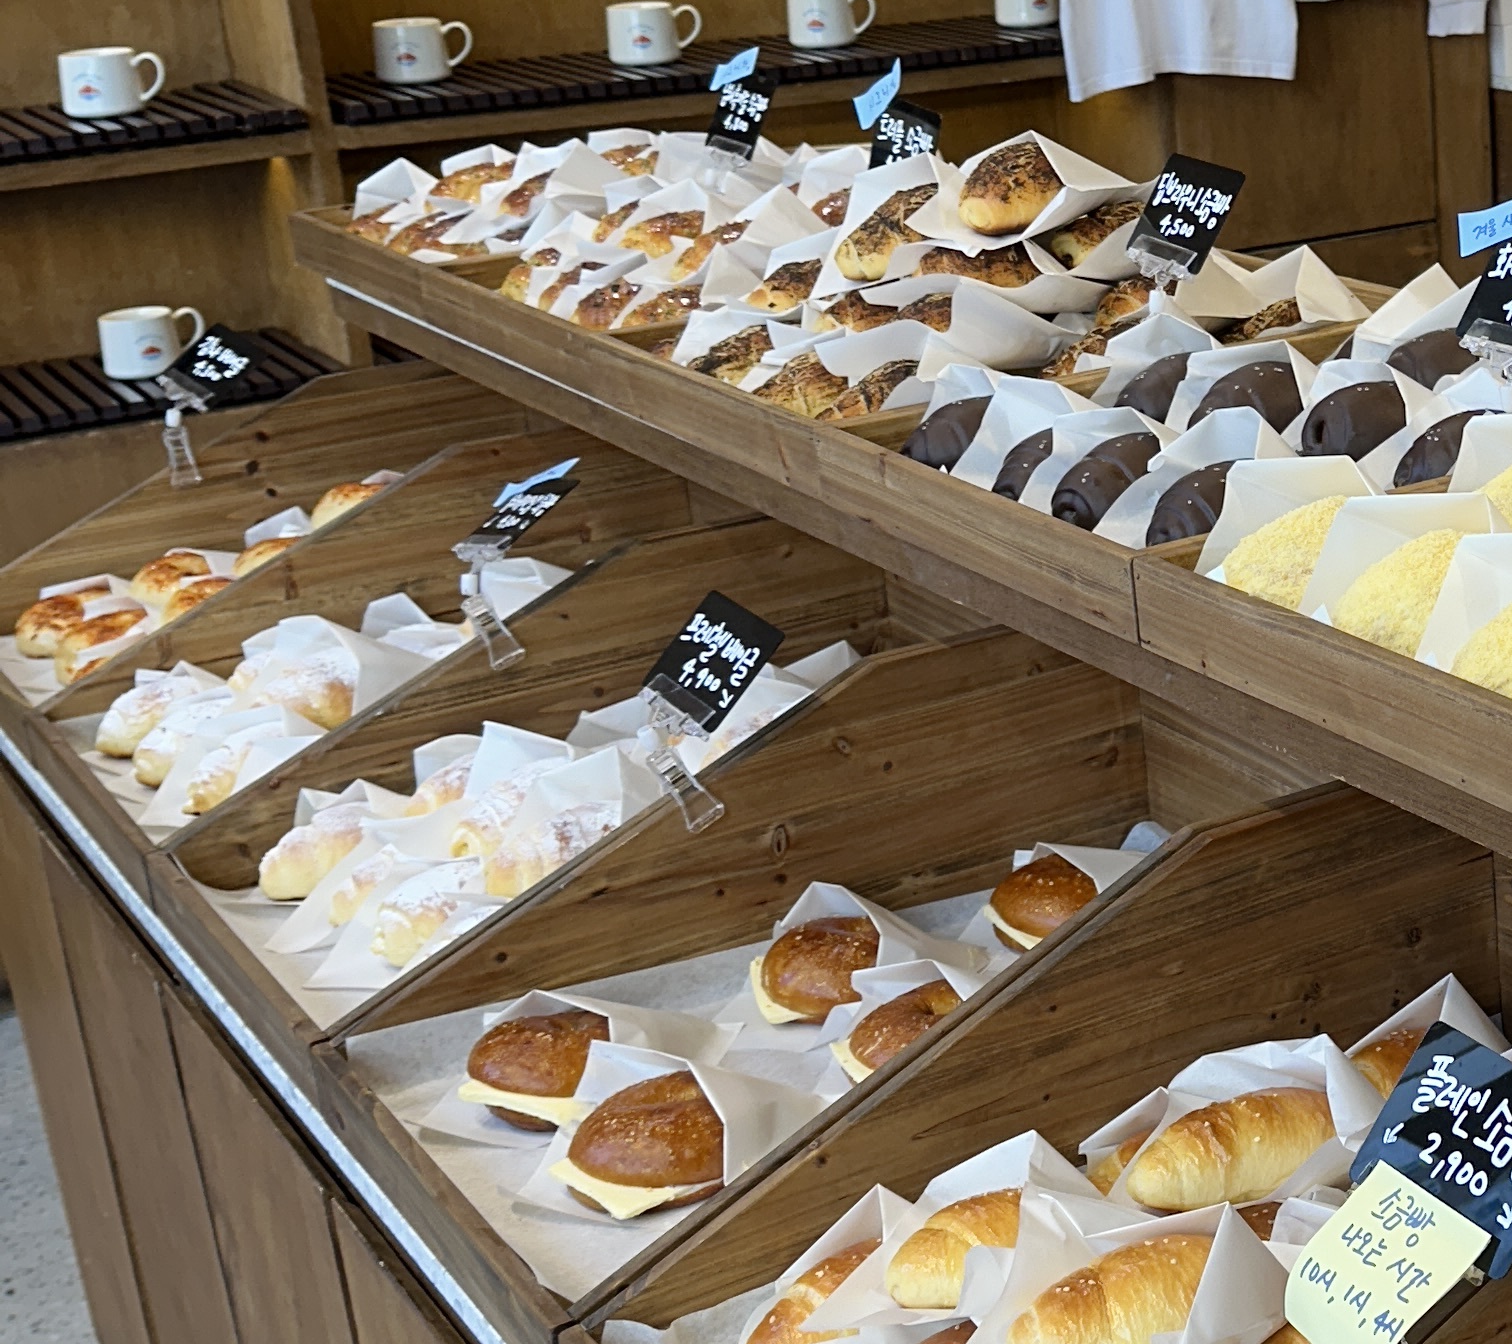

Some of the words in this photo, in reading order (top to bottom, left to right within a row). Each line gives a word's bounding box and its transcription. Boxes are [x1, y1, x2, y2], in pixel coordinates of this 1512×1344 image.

[1159, 213, 1195, 237] 4,500
[1194, 188, 1232, 230] 소금빵
[1472, 218, 1497, 240] 겨울
[678, 658, 721, 691] 4,900
[1412, 1055, 1491, 1140] 플레인
[1419, 1133, 1488, 1196] 2,900
[1371, 1187, 1436, 1250] 소금빵
[1341, 1223, 1388, 1268] 나오는
[1386, 1258, 1431, 1304] 시간
[1373, 1311, 1405, 1343] 4시
